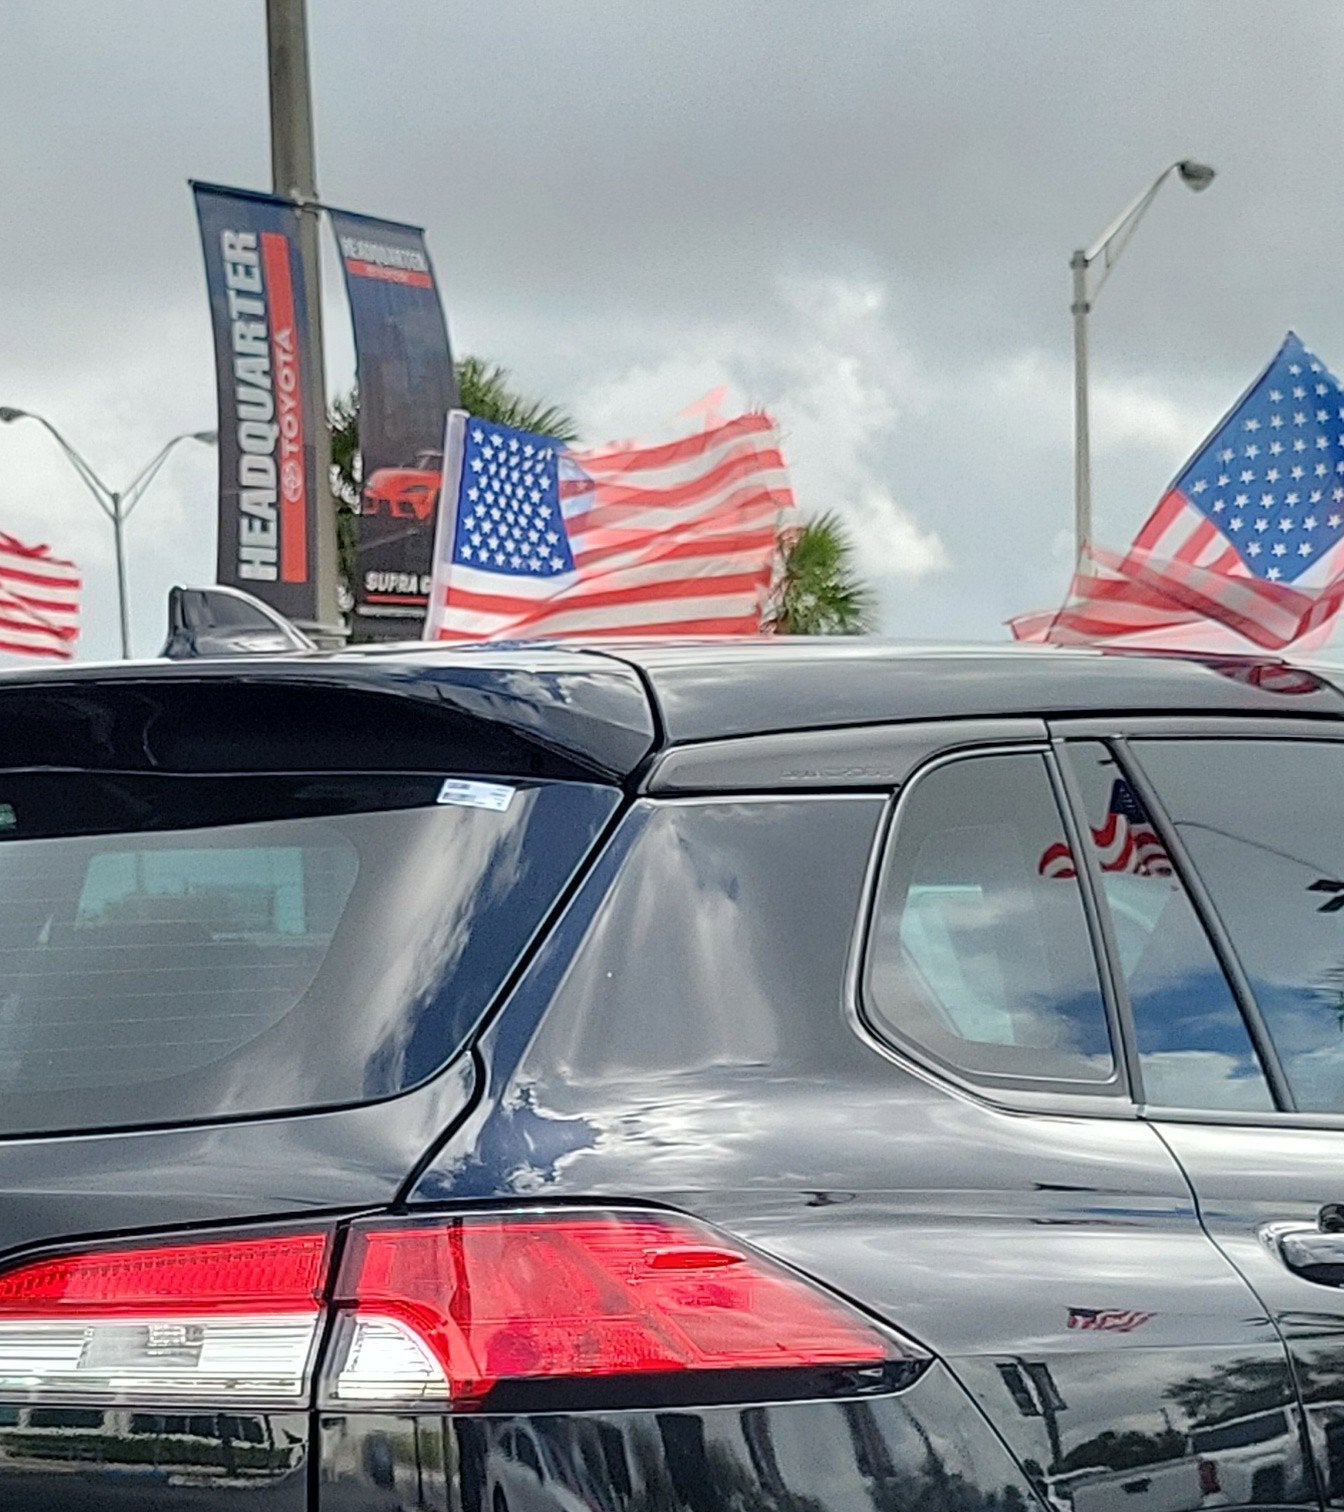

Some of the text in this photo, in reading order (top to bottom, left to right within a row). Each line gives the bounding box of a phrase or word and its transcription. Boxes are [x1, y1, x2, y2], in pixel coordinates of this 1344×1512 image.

[221, 229, 279, 582] HEADQUARTER
[274, 327, 301, 456] TOYOTA
[365, 570, 418, 595] SUPRA
